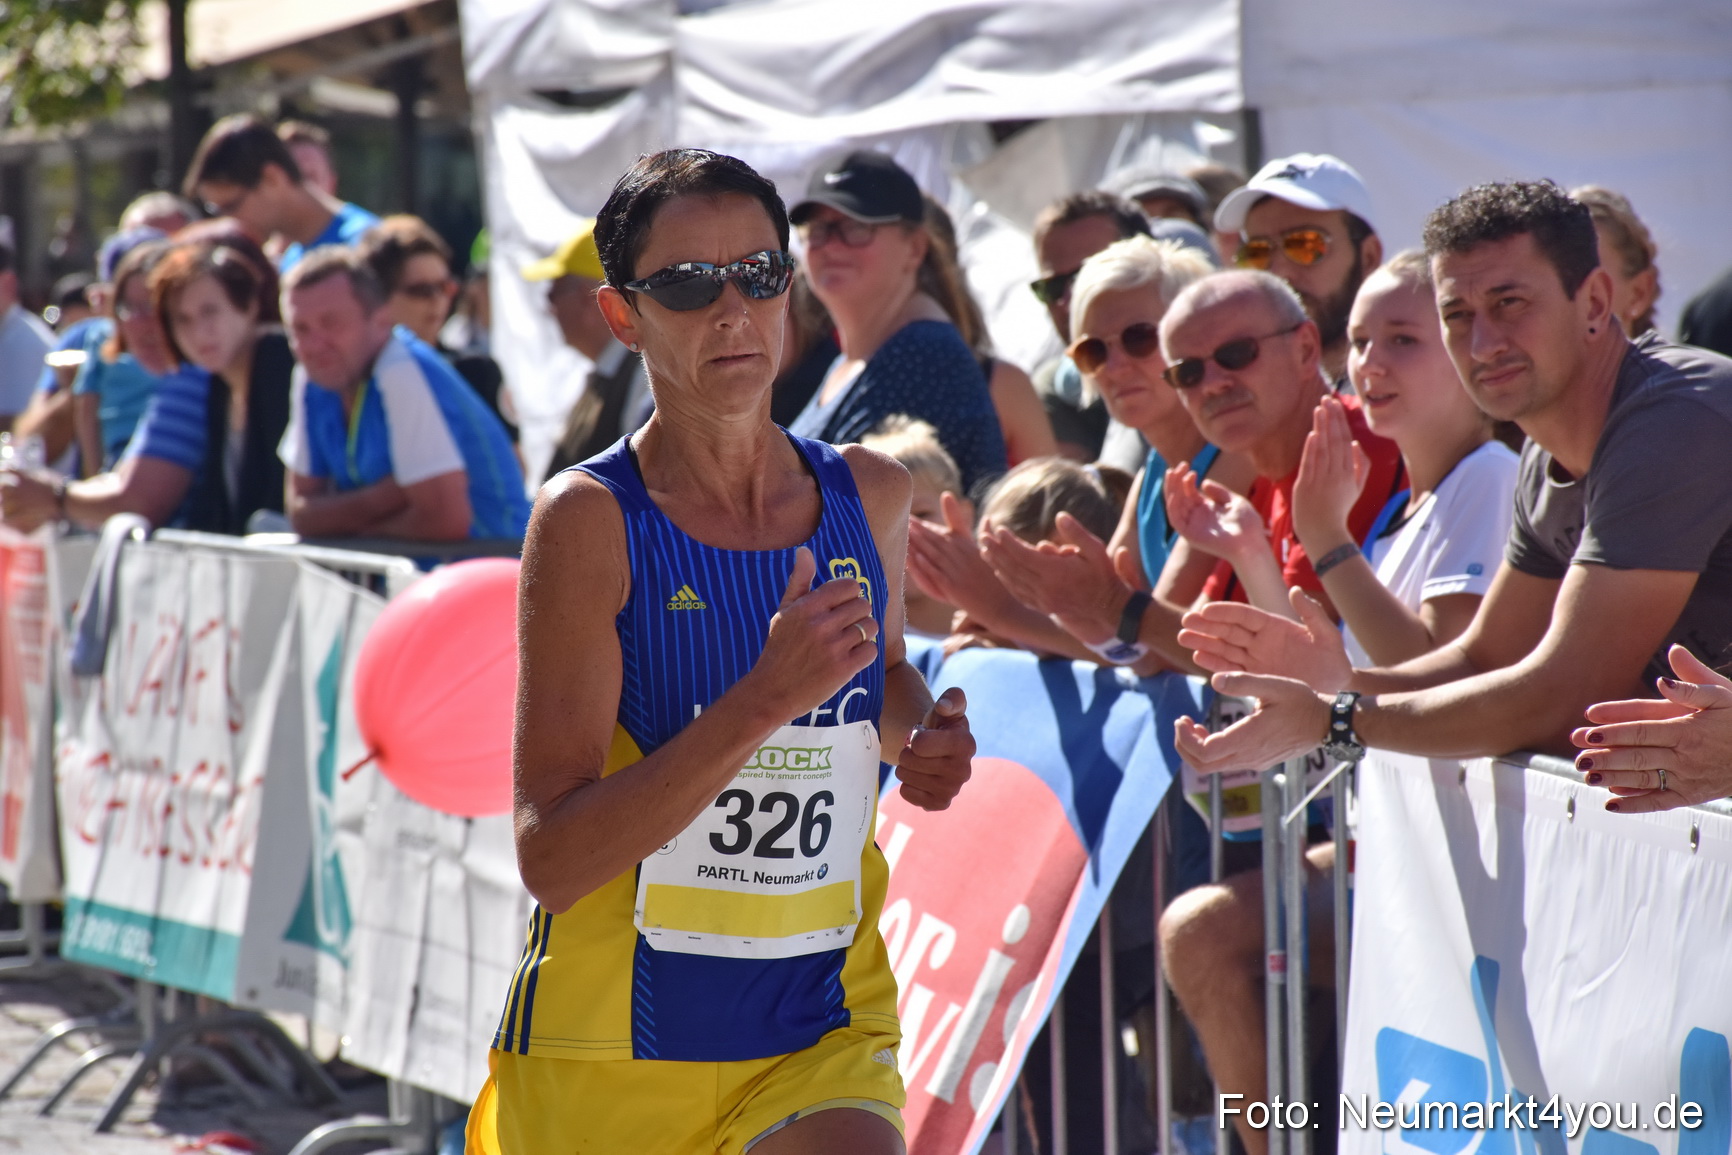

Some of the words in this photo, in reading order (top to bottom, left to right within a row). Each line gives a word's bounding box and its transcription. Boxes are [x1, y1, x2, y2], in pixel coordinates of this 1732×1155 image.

[666, 600, 707, 610] adidas
[736, 771, 763, 779] spired
[765, 771, 776, 780] by
[802, 771, 832, 780] concepts
[708, 788, 835, 859] 326
[697, 864, 750, 883] PARTL
[753, 869, 815, 885] Neumarkt
